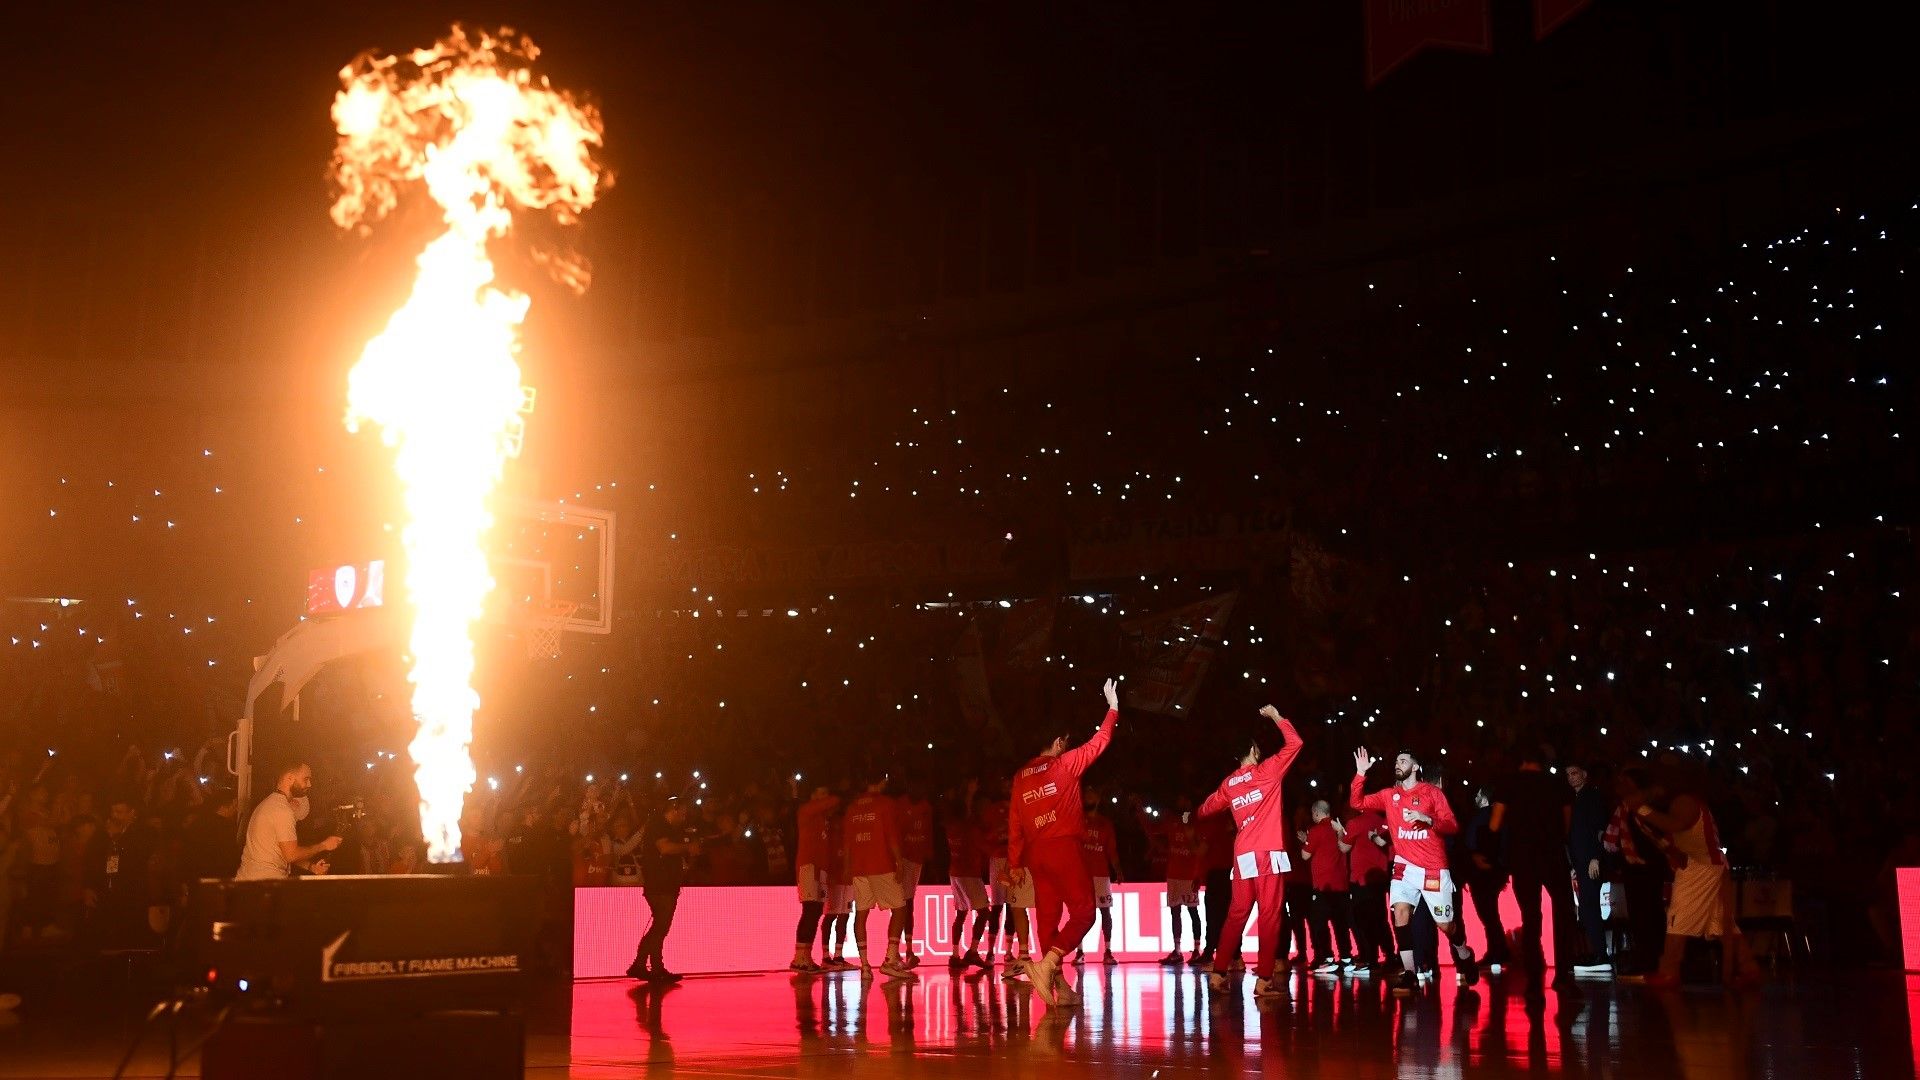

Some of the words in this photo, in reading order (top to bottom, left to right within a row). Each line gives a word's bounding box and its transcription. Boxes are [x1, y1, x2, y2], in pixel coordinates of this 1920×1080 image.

[1023, 782, 1057, 804] FMS
[1232, 788, 1263, 810] FMS
[1397, 825, 1428, 840] bwin
[333, 959, 405, 977] FIREBOLT
[456, 954, 518, 969] MACHINE
